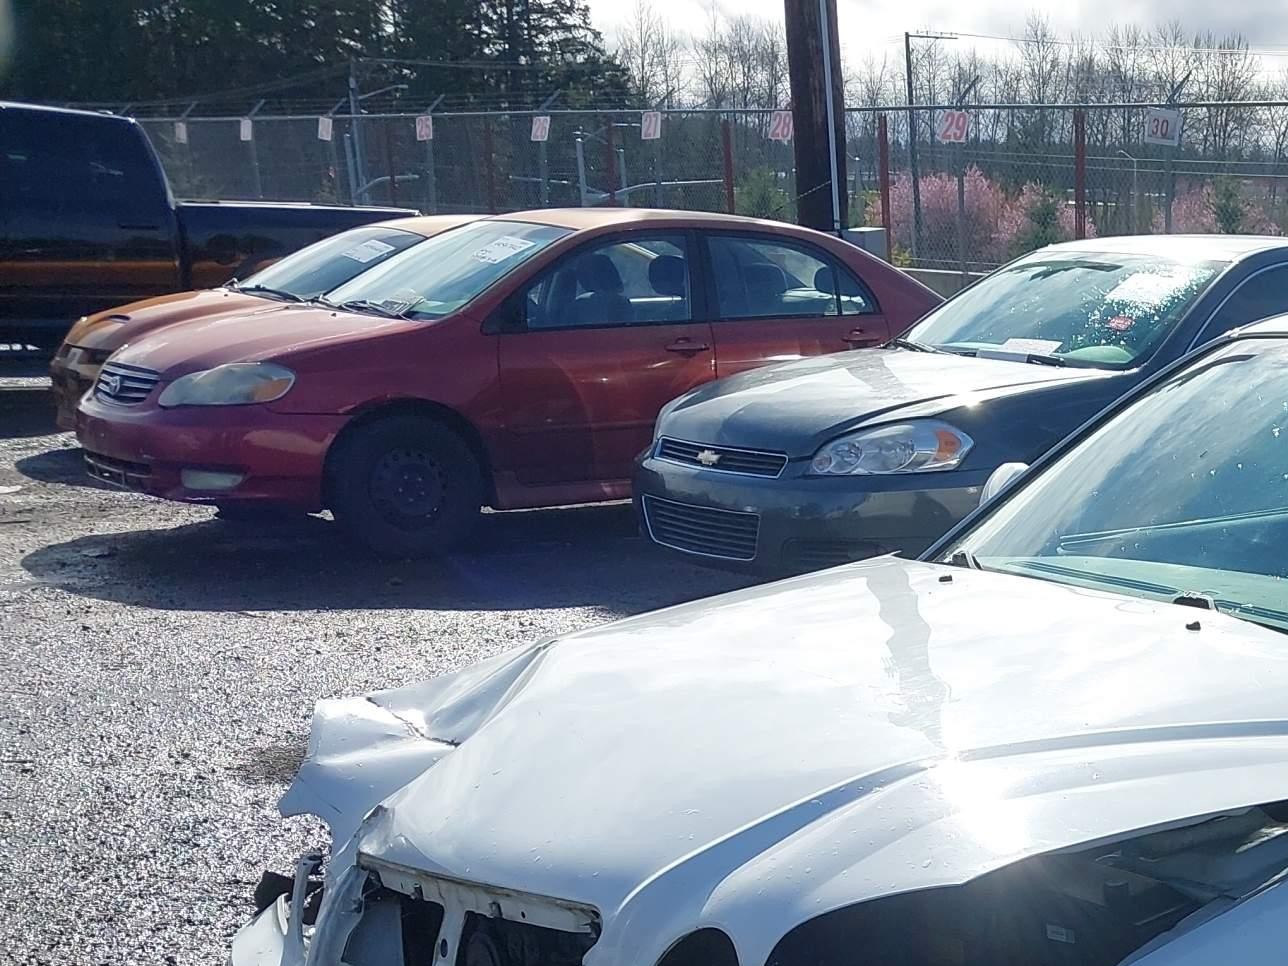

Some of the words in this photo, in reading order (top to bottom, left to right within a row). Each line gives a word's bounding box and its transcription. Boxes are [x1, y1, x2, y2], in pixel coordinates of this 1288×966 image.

[533, 117, 549, 140] 26
[643, 112, 660, 138] 27
[771, 112, 792, 139] 28
[943, 112, 968, 140] 29
[1151, 118, 1169, 137] 30
